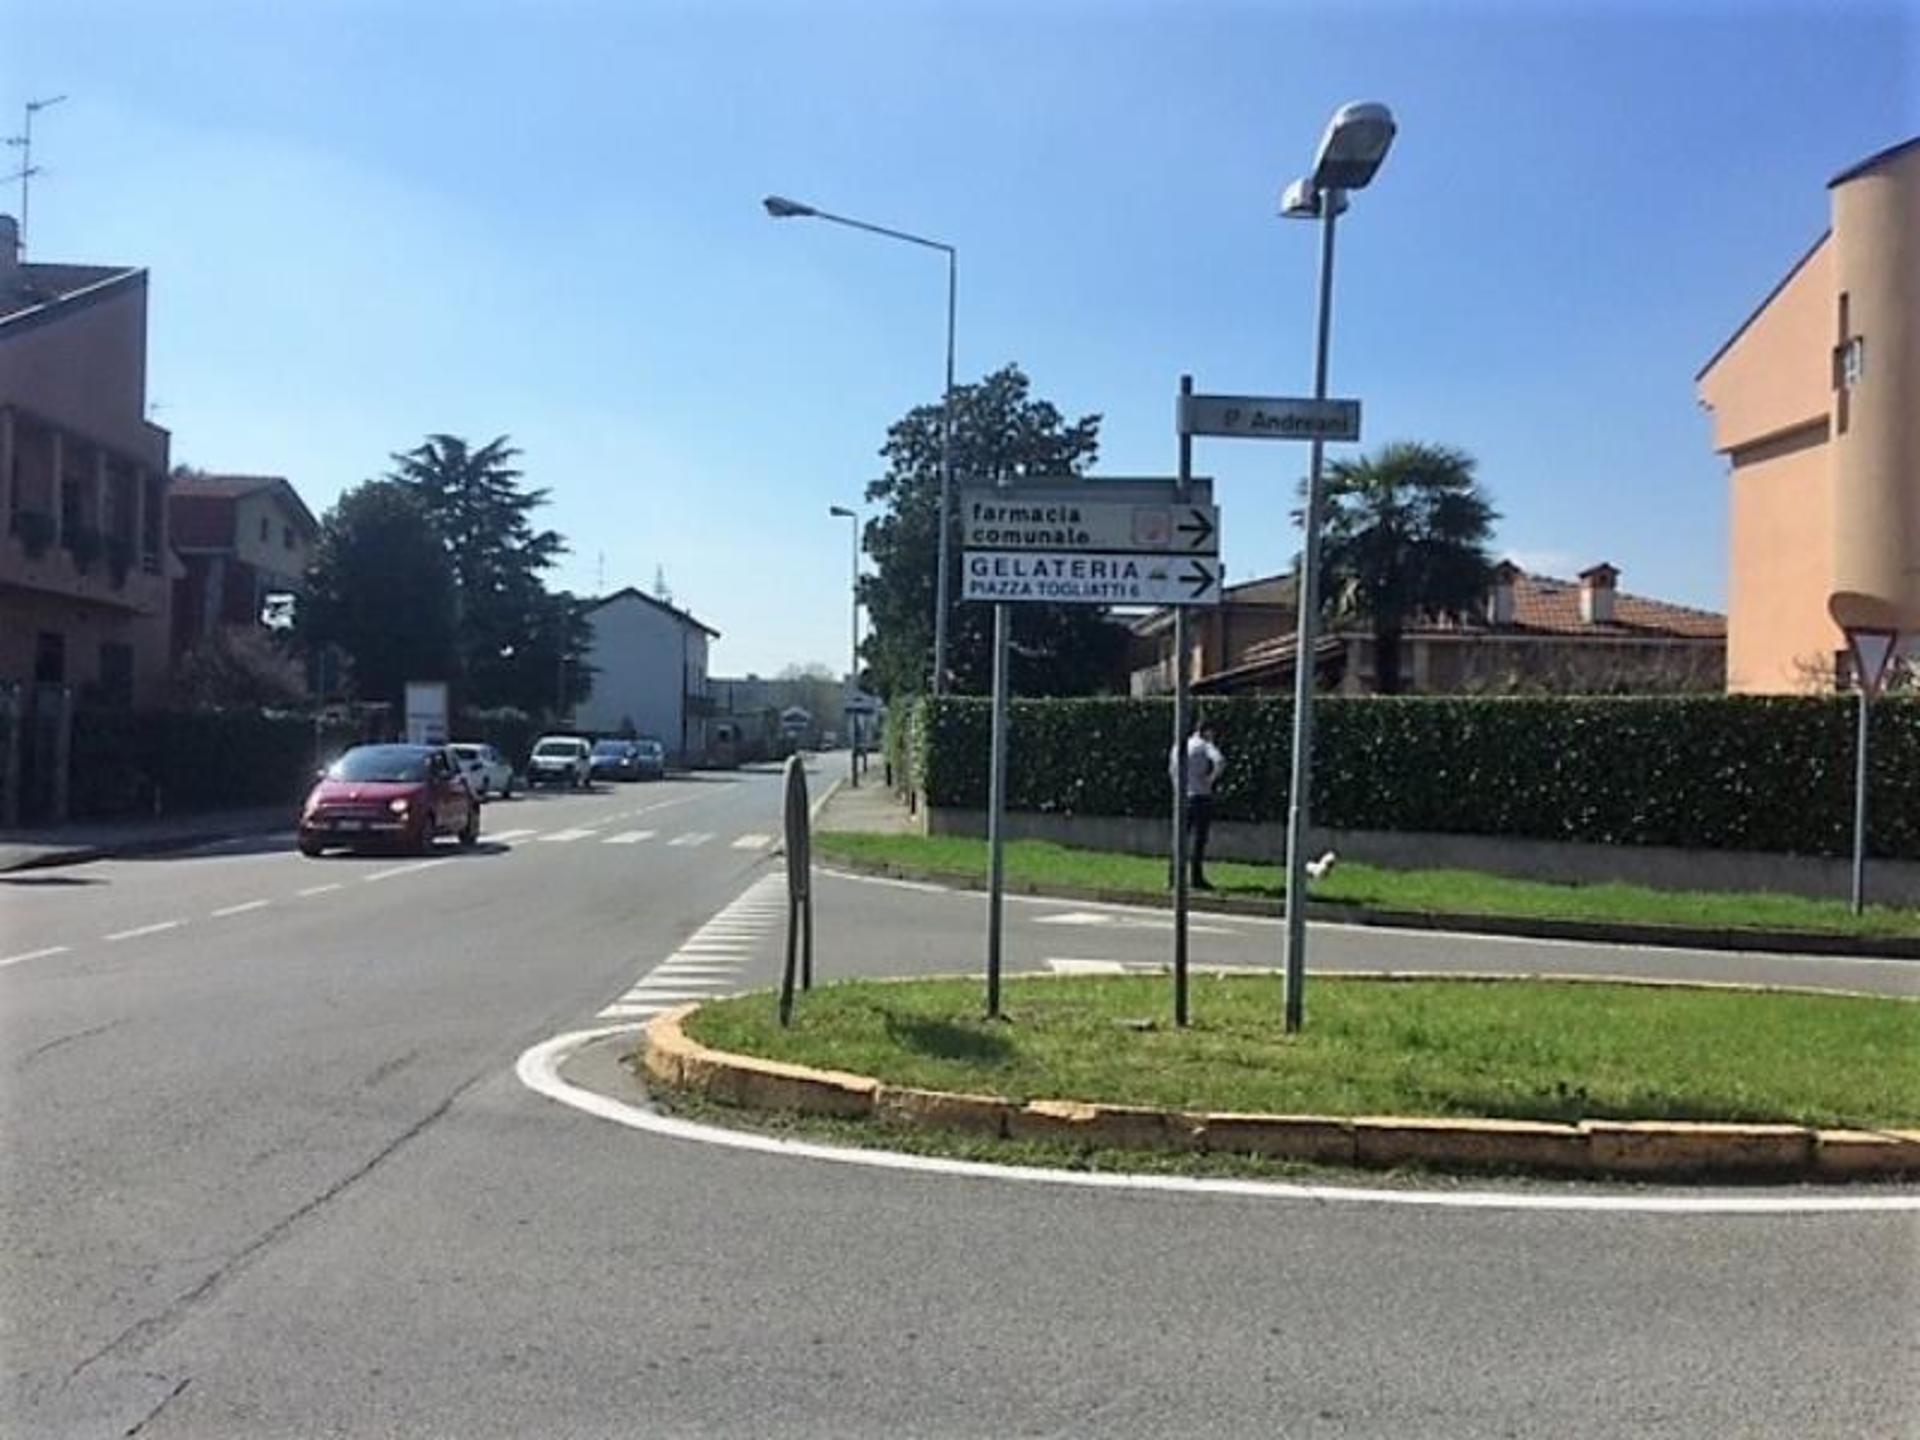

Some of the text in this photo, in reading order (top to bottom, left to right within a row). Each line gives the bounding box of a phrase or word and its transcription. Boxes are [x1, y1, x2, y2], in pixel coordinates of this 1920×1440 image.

[973, 503, 1081, 523] farmacia
[972, 527, 1091, 544] comunale
[970, 557, 1139, 579] GELATERIA
[970, 580, 1032, 596] PIAZZA
[1037, 581, 1126, 598] TOGLIATTI
